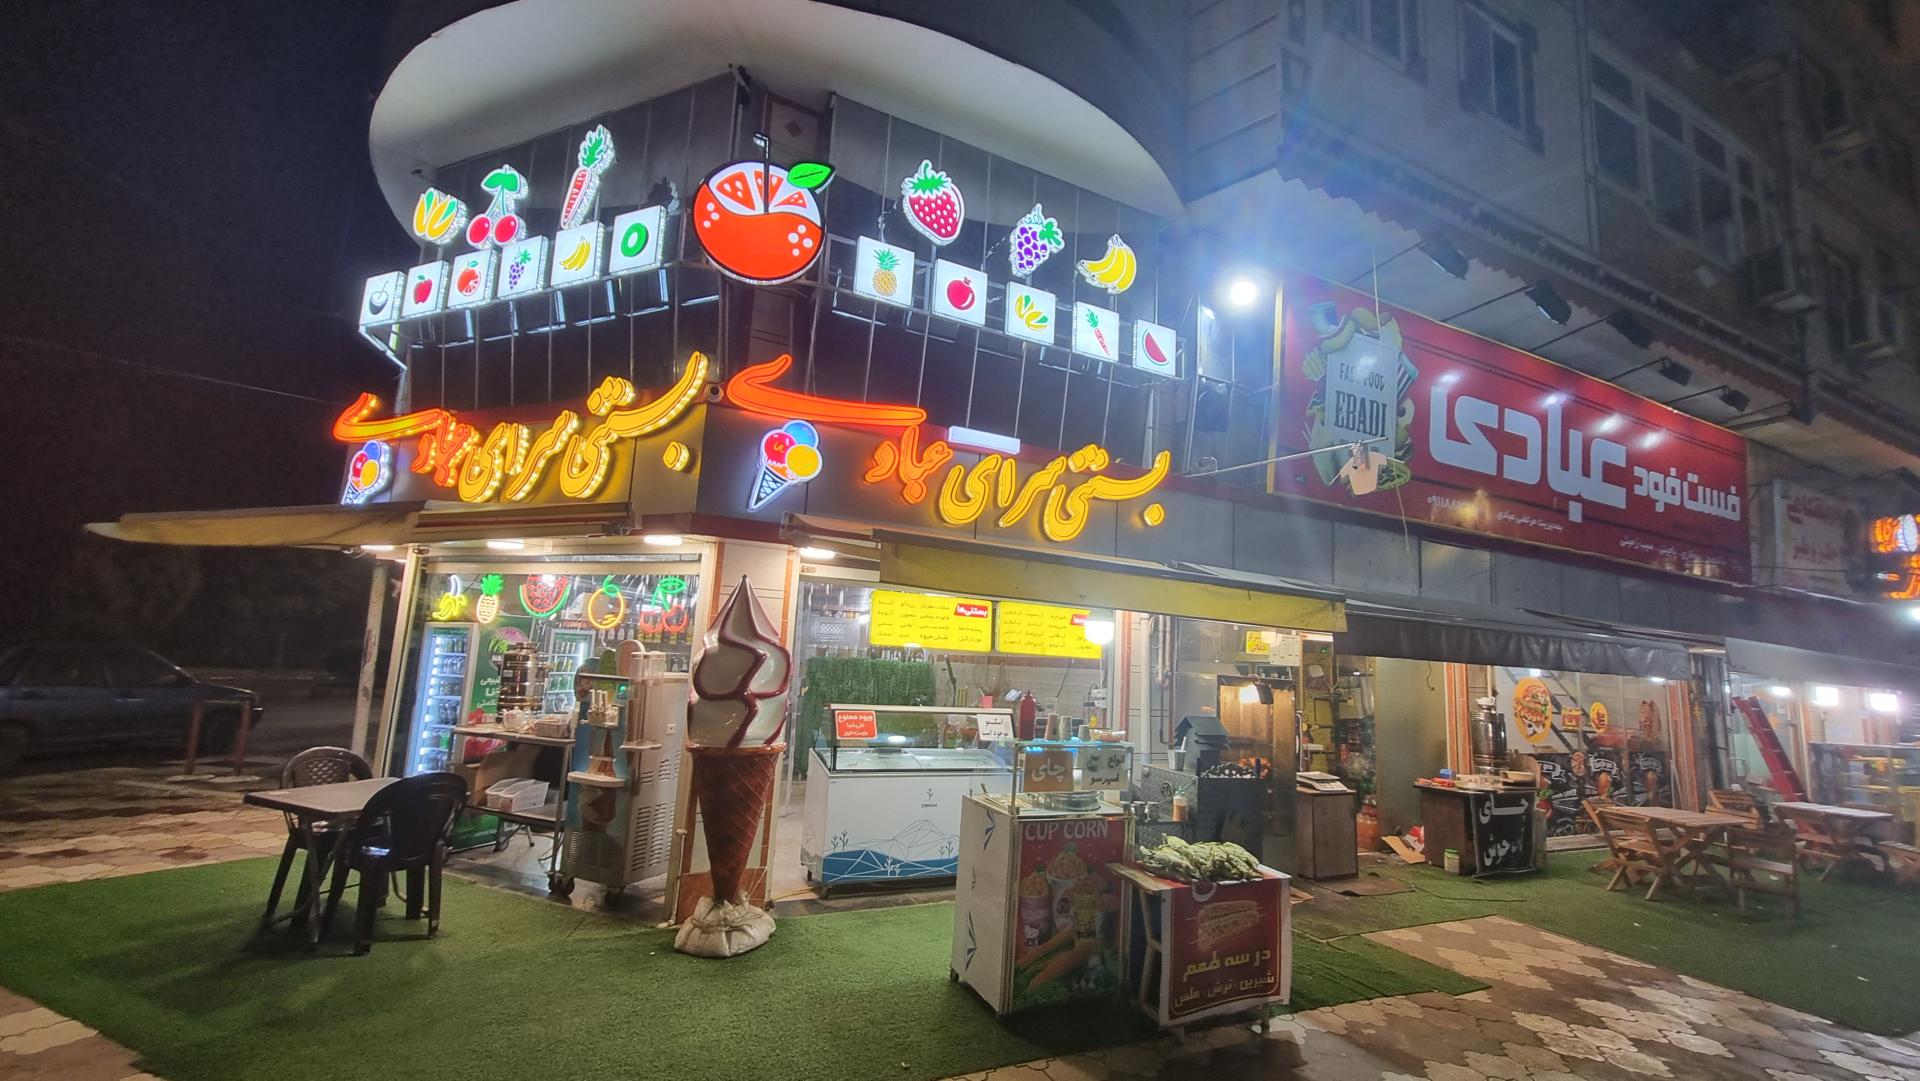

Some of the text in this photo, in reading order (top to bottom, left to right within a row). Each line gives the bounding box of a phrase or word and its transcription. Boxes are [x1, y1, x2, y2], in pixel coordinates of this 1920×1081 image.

[560, 351, 709, 499] بستنی
[1334, 390, 1387, 438] EBADI
[1429, 384, 1627, 523] عبادی
[1043, 443, 1171, 541] بستنی
[1633, 465, 1682, 513] فود
[1683, 472, 1741, 521] فست
[1031, 757, 1065, 784] چای
[1025, 821, 1109, 842] CUP CORN
[1183, 949, 1271, 983] در سه طعم
[1207, 979, 1233, 998] ترش
[1240, 969, 1275, 991] شیرین
